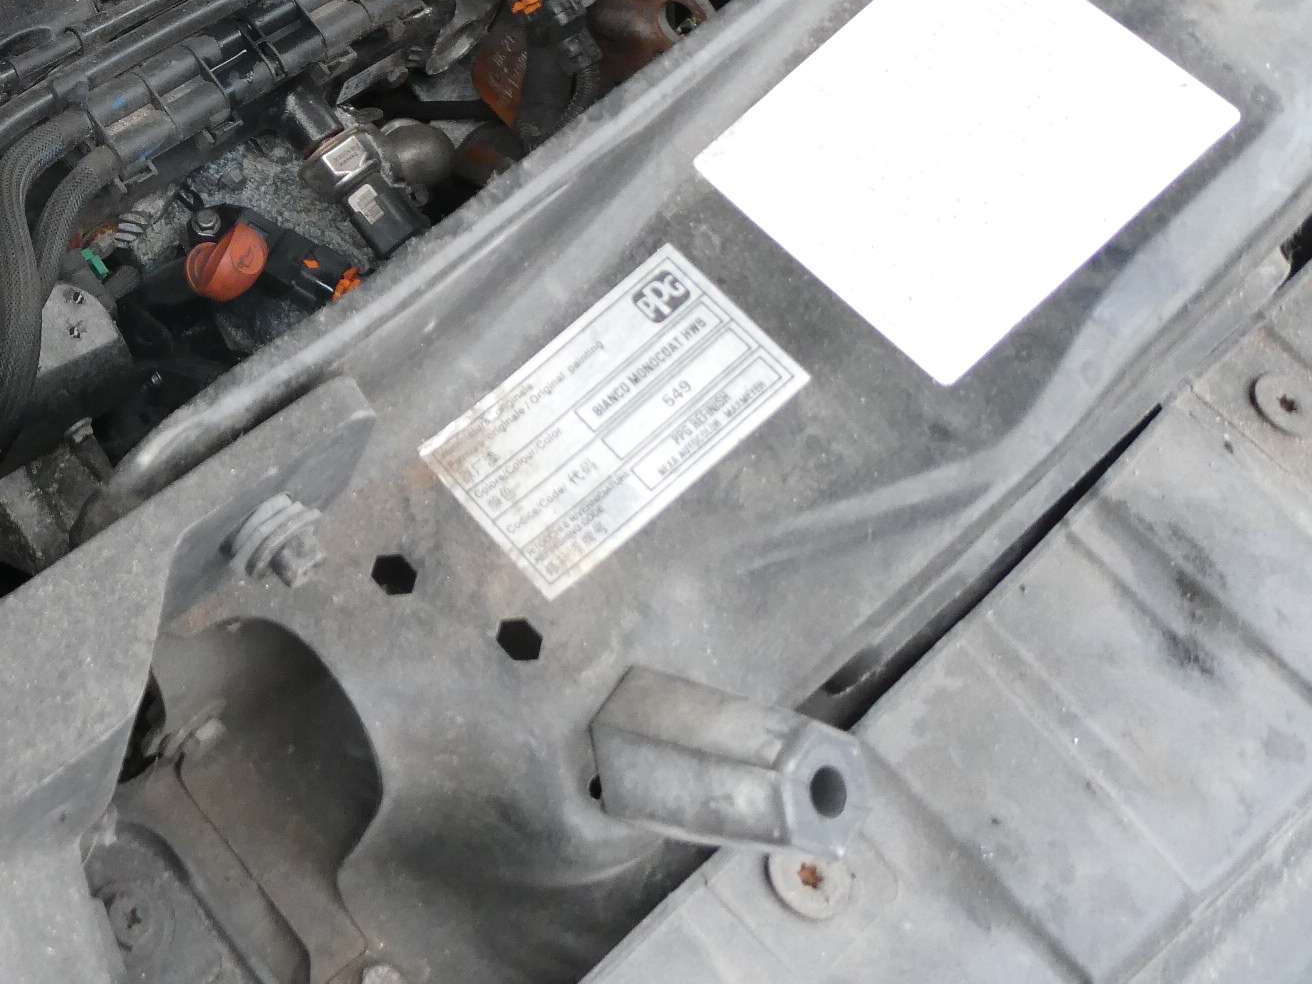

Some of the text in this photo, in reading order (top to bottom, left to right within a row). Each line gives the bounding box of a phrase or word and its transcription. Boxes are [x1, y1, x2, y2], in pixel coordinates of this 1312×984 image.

[633, 271, 692, 321] PPG
[590, 381, 631, 417] BIANCO
[625, 335, 685, 386] MONOCOAT
[662, 379, 693, 408] 549
[687, 389, 732, 429] REFINISH
